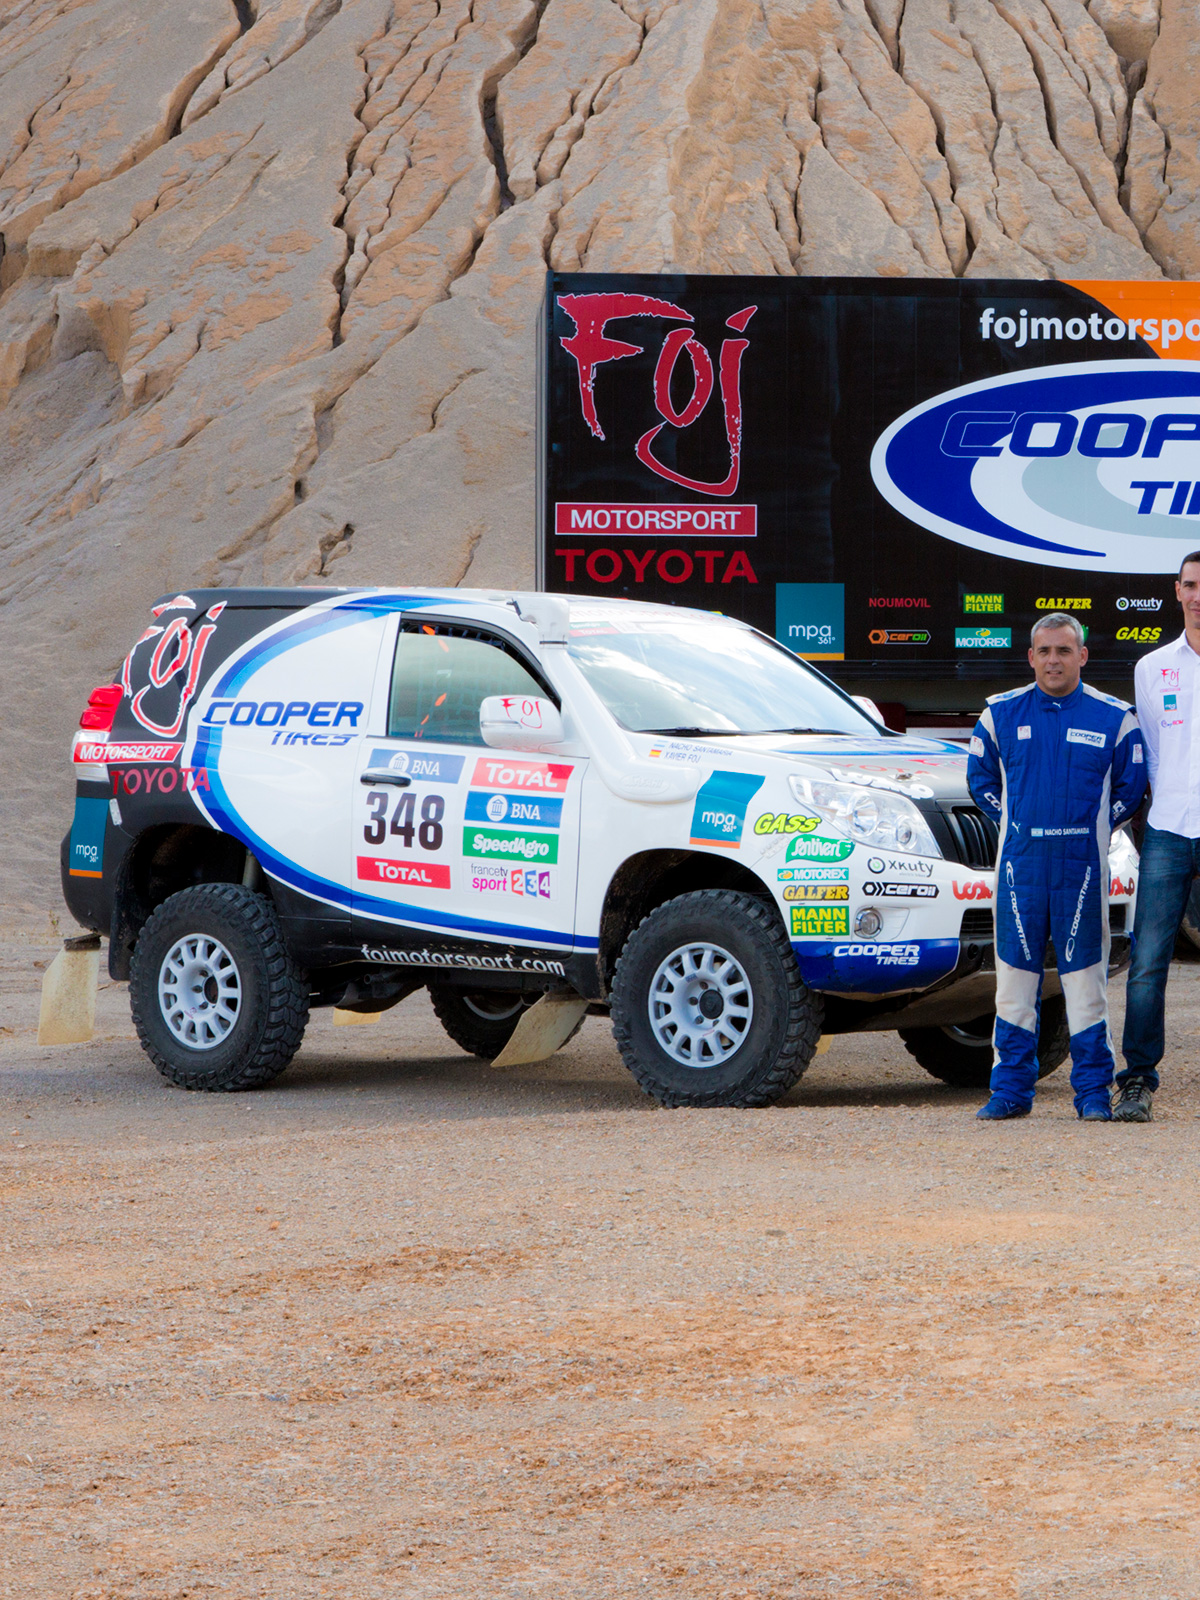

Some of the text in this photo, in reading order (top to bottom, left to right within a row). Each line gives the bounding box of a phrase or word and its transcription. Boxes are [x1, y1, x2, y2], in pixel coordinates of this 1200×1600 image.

[556, 292, 758, 496] Foj
[570, 509, 742, 531] MOTORSPORT
[555, 548, 759, 584] TOYOTA
[868, 598, 931, 608] NOUMOVIL
[965, 595, 1002, 603] MANN
[1035, 597, 1092, 609] GALFER
[1130, 597, 1163, 611] xkuty
[965, 603, 1002, 612] FILTER
[789, 625, 832, 641] mpa
[889, 633, 928, 641] ceroil
[1115, 627, 1163, 640] GASS
[955, 637, 1009, 647] MOTOREX
[202, 701, 364, 727] COOPER
[270, 730, 359, 746] TIRES
[1070, 731, 1103, 742] COOPER
[79, 745, 173, 759] MOTORSPORT
[411, 760, 441, 776] BNA
[486, 762, 558, 788] TOTAL
[110, 767, 210, 795] TOYOTA
[510, 803, 541, 820] BNA
[702, 811, 736, 827] mpa
[363, 791, 445, 851] 348
[754, 813, 822, 835] GASS
[472, 833, 549, 858] SpeedAgro
[375, 861, 432, 883] TOTAL
[471, 863, 509, 877] francetv
[794, 868, 847, 881] MOTOREX
[889, 859, 934, 878] xkuty
[472, 877, 507, 893] sport
[783, 884, 850, 901] GALFER
[885, 883, 936, 897] ceroil
[792, 907, 846, 920] MANN
[792, 921, 847, 934] FILTER
[834, 945, 920, 957] COOPER
[876, 956, 920, 966] TIRES
